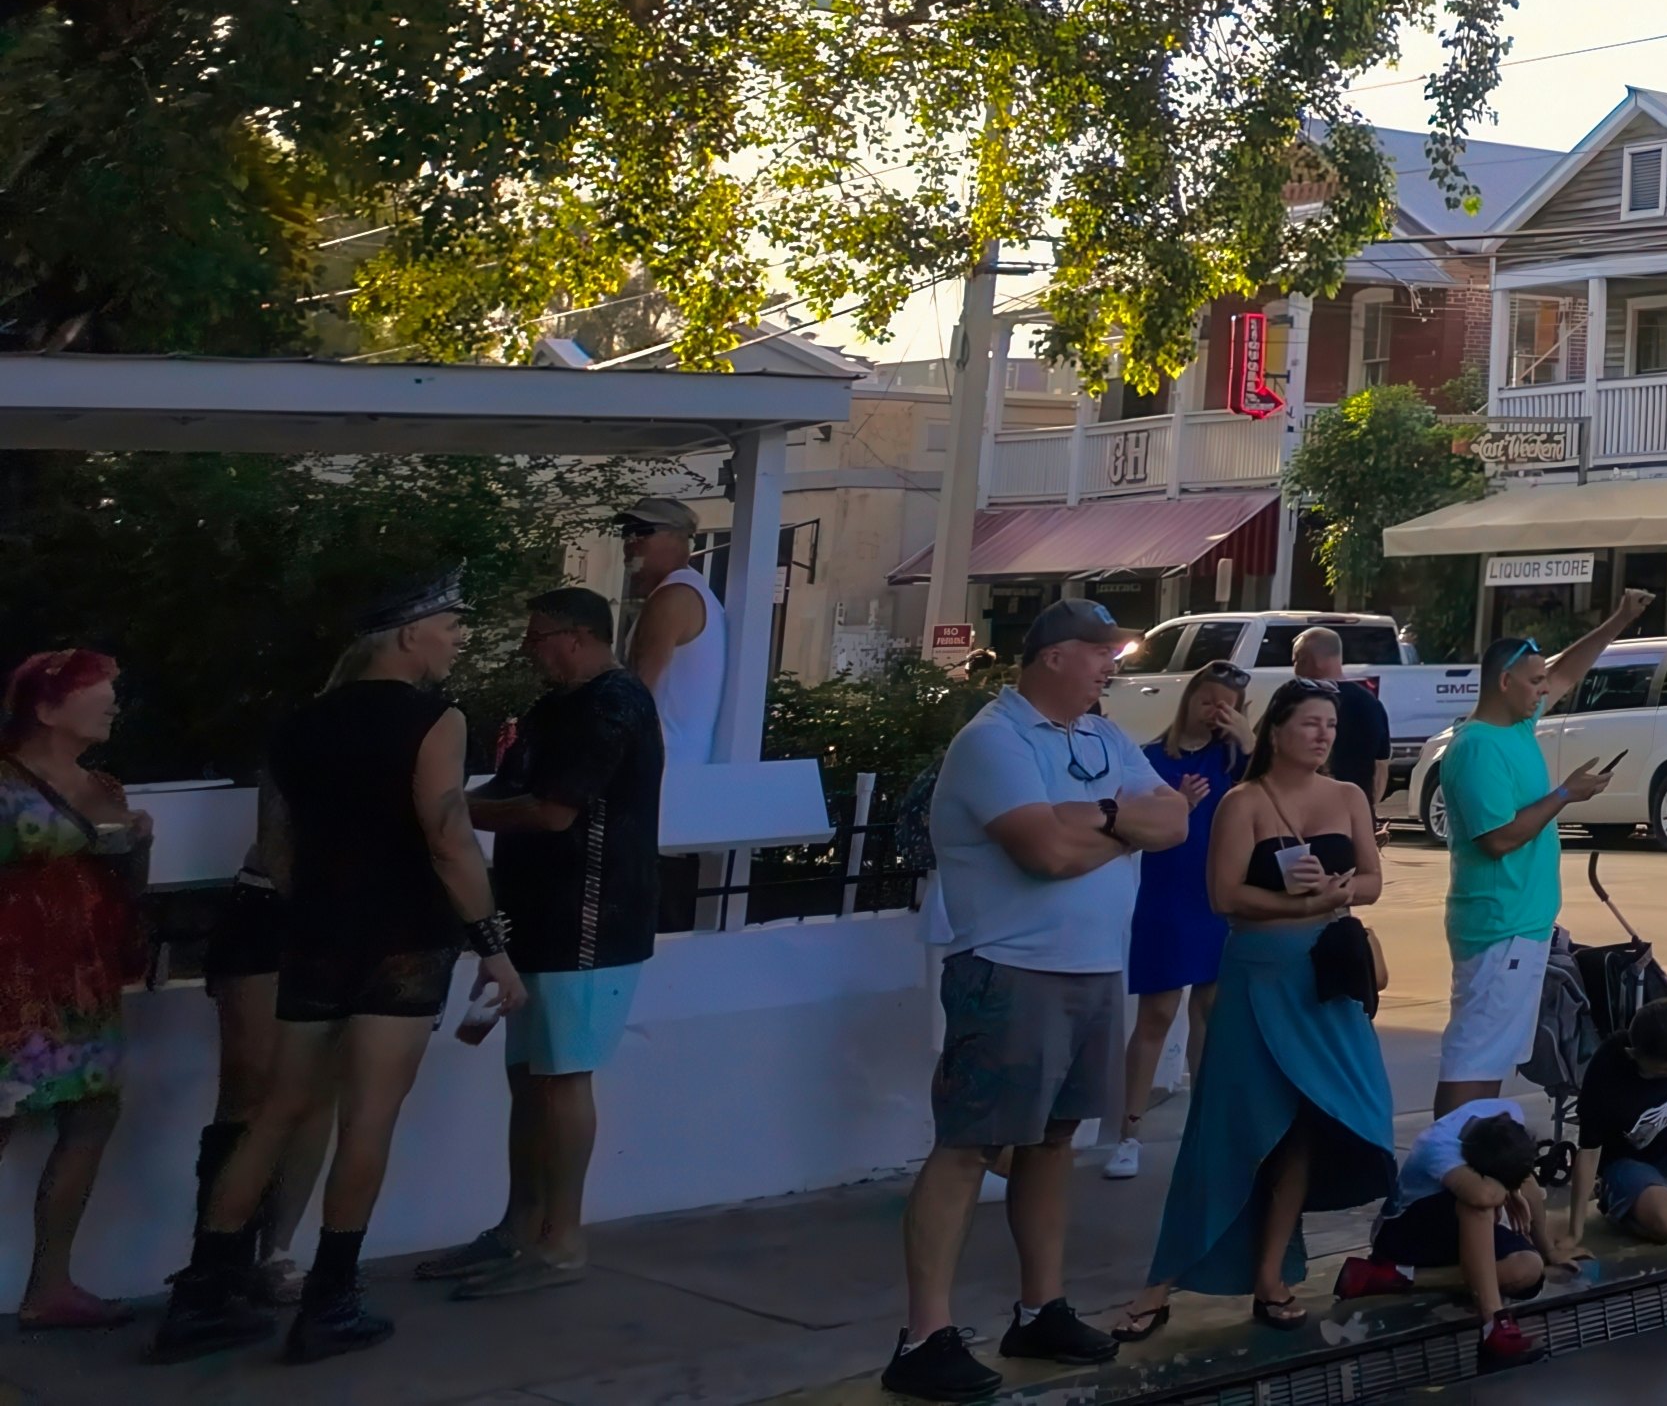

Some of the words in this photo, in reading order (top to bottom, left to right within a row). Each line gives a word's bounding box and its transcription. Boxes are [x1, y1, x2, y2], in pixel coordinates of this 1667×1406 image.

[1489, 561, 1541, 579] LIQUOR
[1544, 559, 1590, 577] STORE
[1436, 683, 1479, 694] GMC
